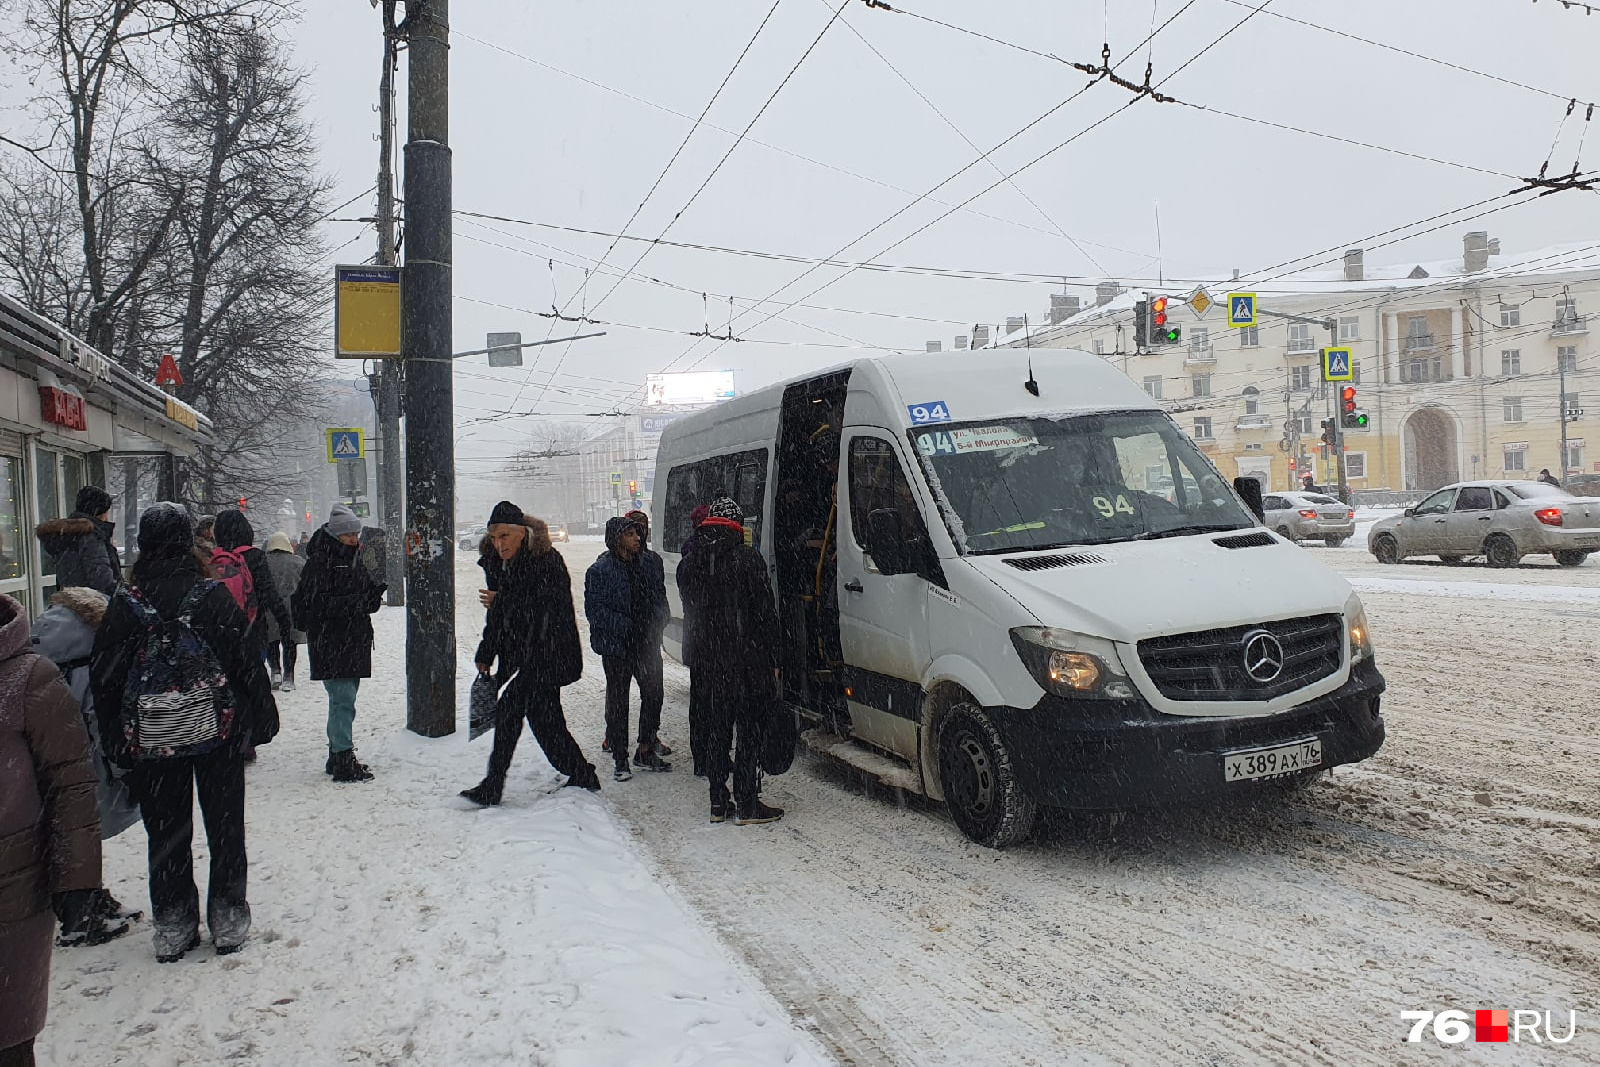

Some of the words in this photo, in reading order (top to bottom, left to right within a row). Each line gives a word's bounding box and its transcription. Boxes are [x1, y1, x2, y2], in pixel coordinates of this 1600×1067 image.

[912, 405, 947, 421] 94
[917, 431, 953, 456] 94
[1092, 494, 1135, 518] 94
[1303, 743, 1318, 760] 76
